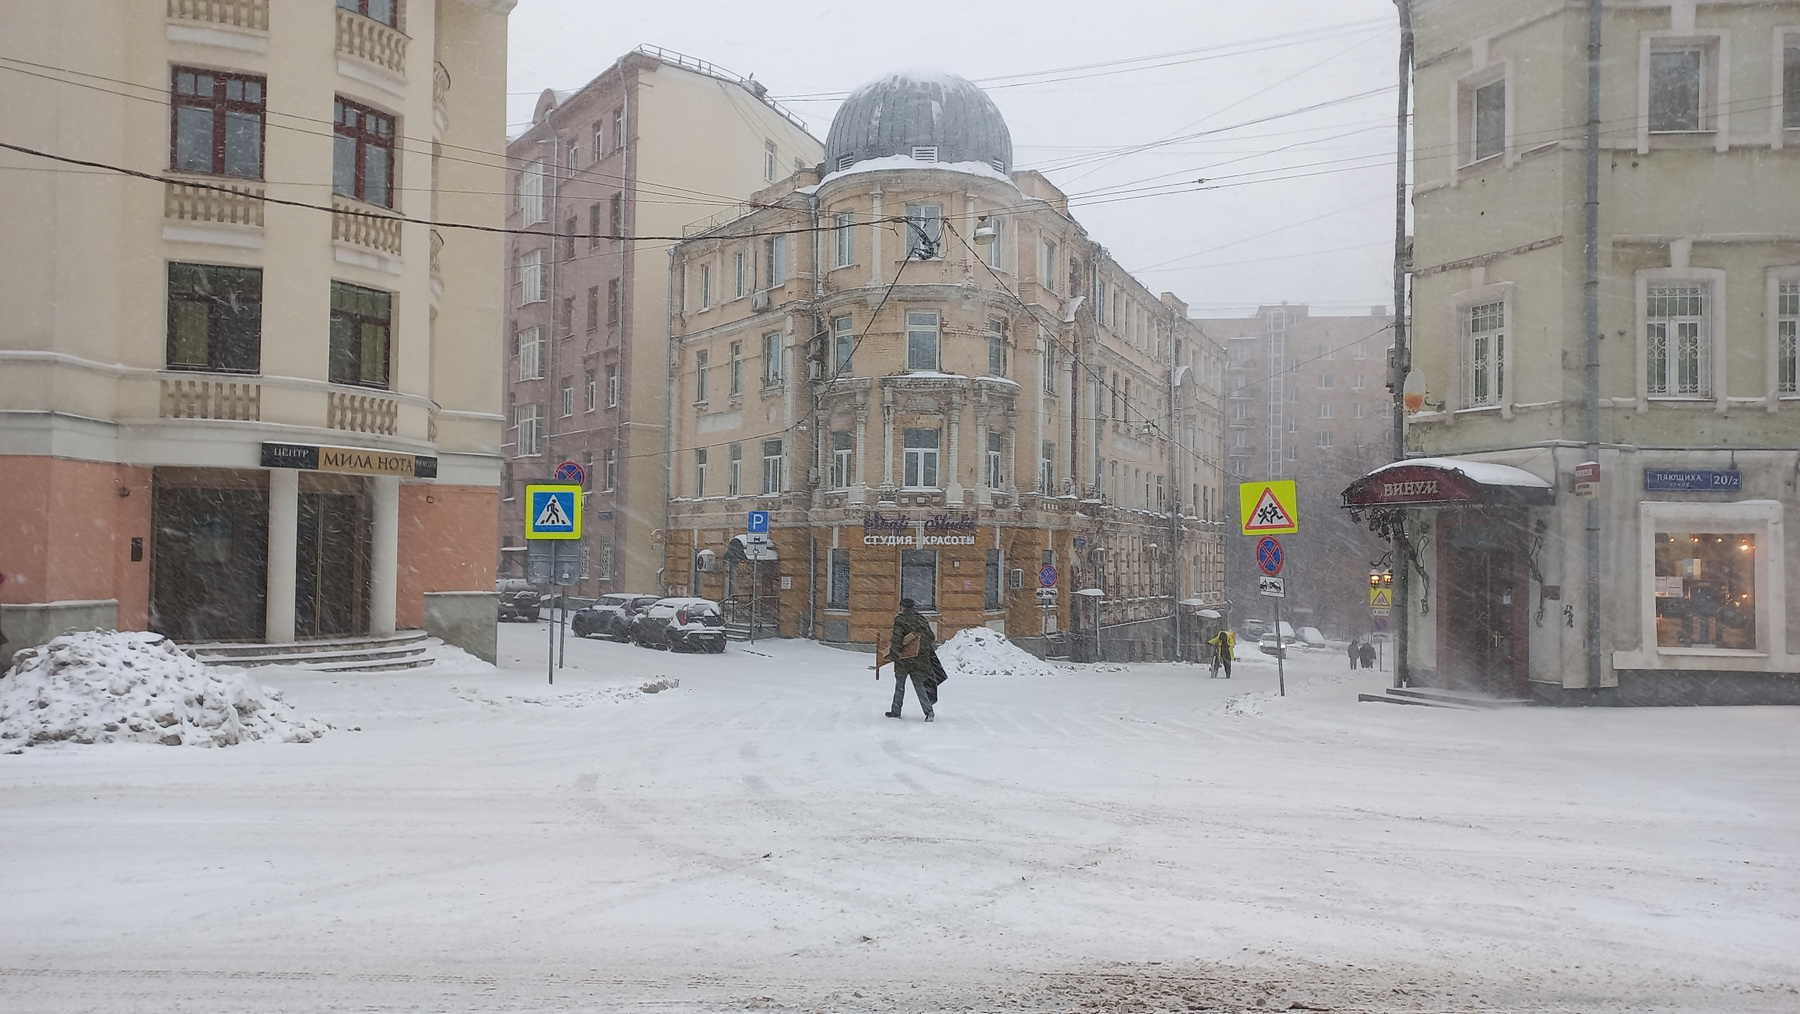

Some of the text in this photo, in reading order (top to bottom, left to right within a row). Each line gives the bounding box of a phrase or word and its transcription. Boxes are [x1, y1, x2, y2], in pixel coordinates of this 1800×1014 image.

[274, 447, 309, 458] ЦЕНТР
[323, 452, 373, 468] МИЛА
[378, 456, 413, 472] НОТА
[1713, 475, 1739, 486] 20/2
[1384, 481, 1439, 497] ВИНУМ
[753, 513, 764, 530] P
[863, 535, 975, 547] СТУДИЯ КРАСОТЫ
